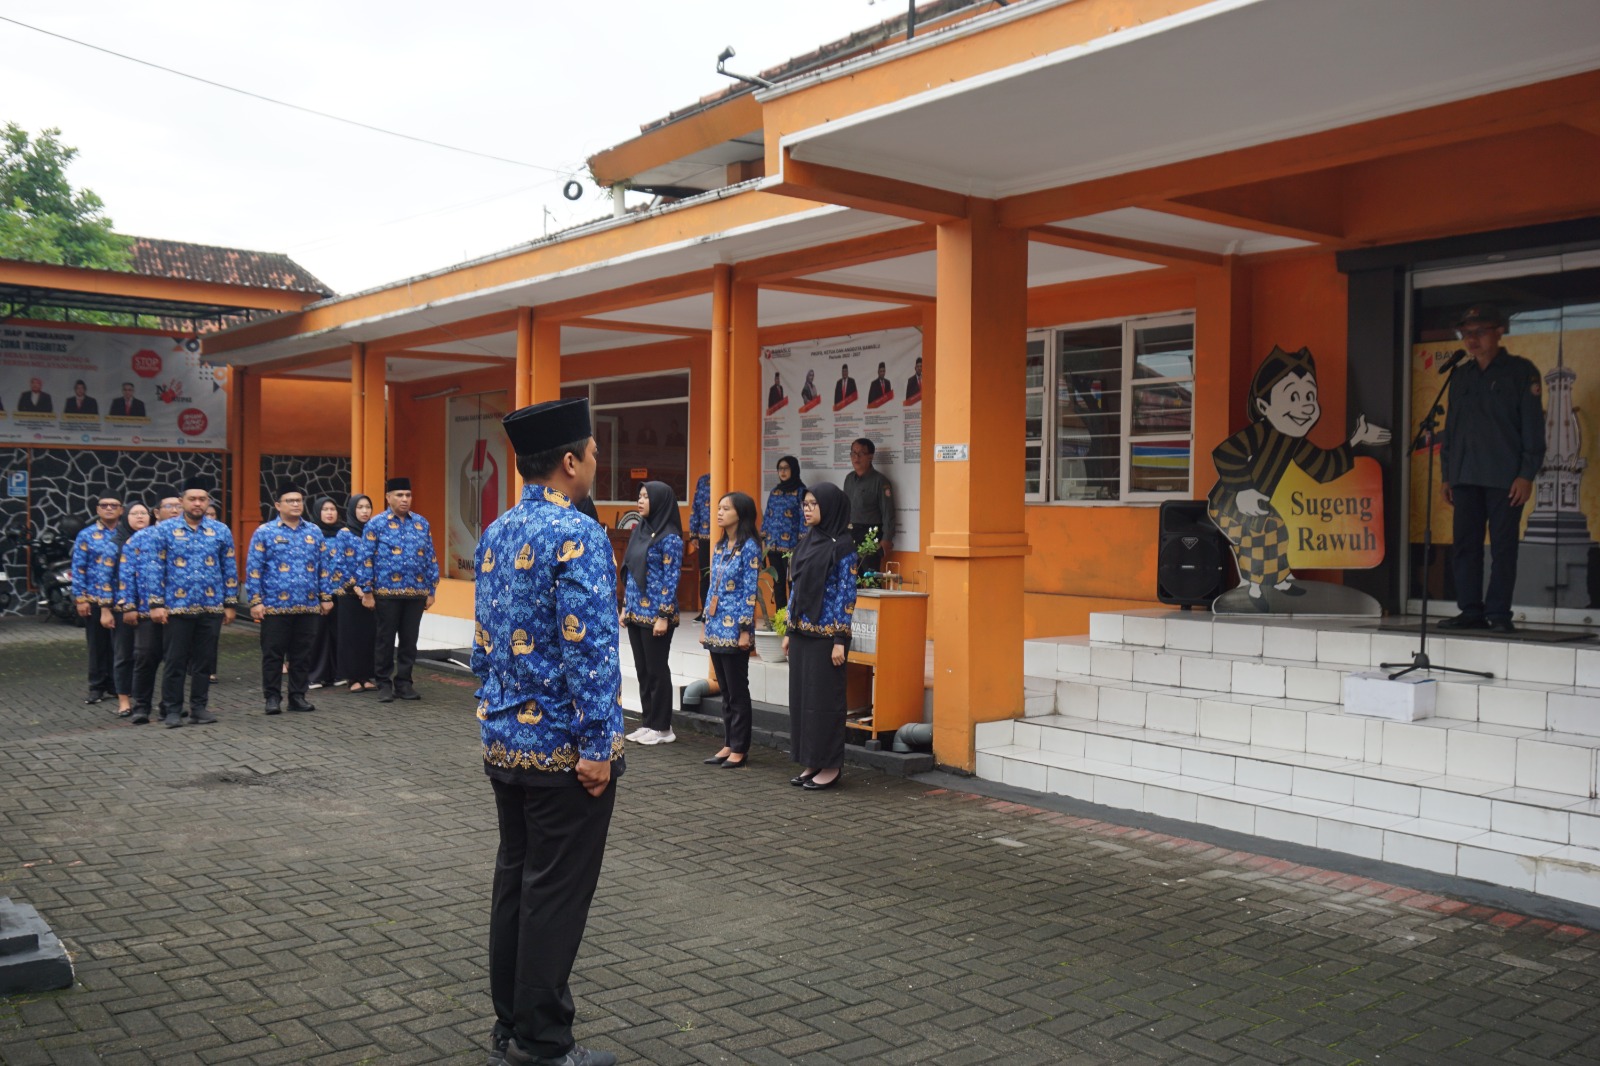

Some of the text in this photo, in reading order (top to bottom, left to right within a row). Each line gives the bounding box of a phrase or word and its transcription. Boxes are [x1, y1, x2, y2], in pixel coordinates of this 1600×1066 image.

[23, 341, 67, 352] INTEGRITAS
[135, 357, 159, 367] STOP
[12, 473, 24, 486] P
[1291, 491, 1372, 522] Sugeng
[1298, 526, 1376, 552] Rawuh
[458, 558, 475, 570] BAWA
[850, 622, 877, 634] WASLU
